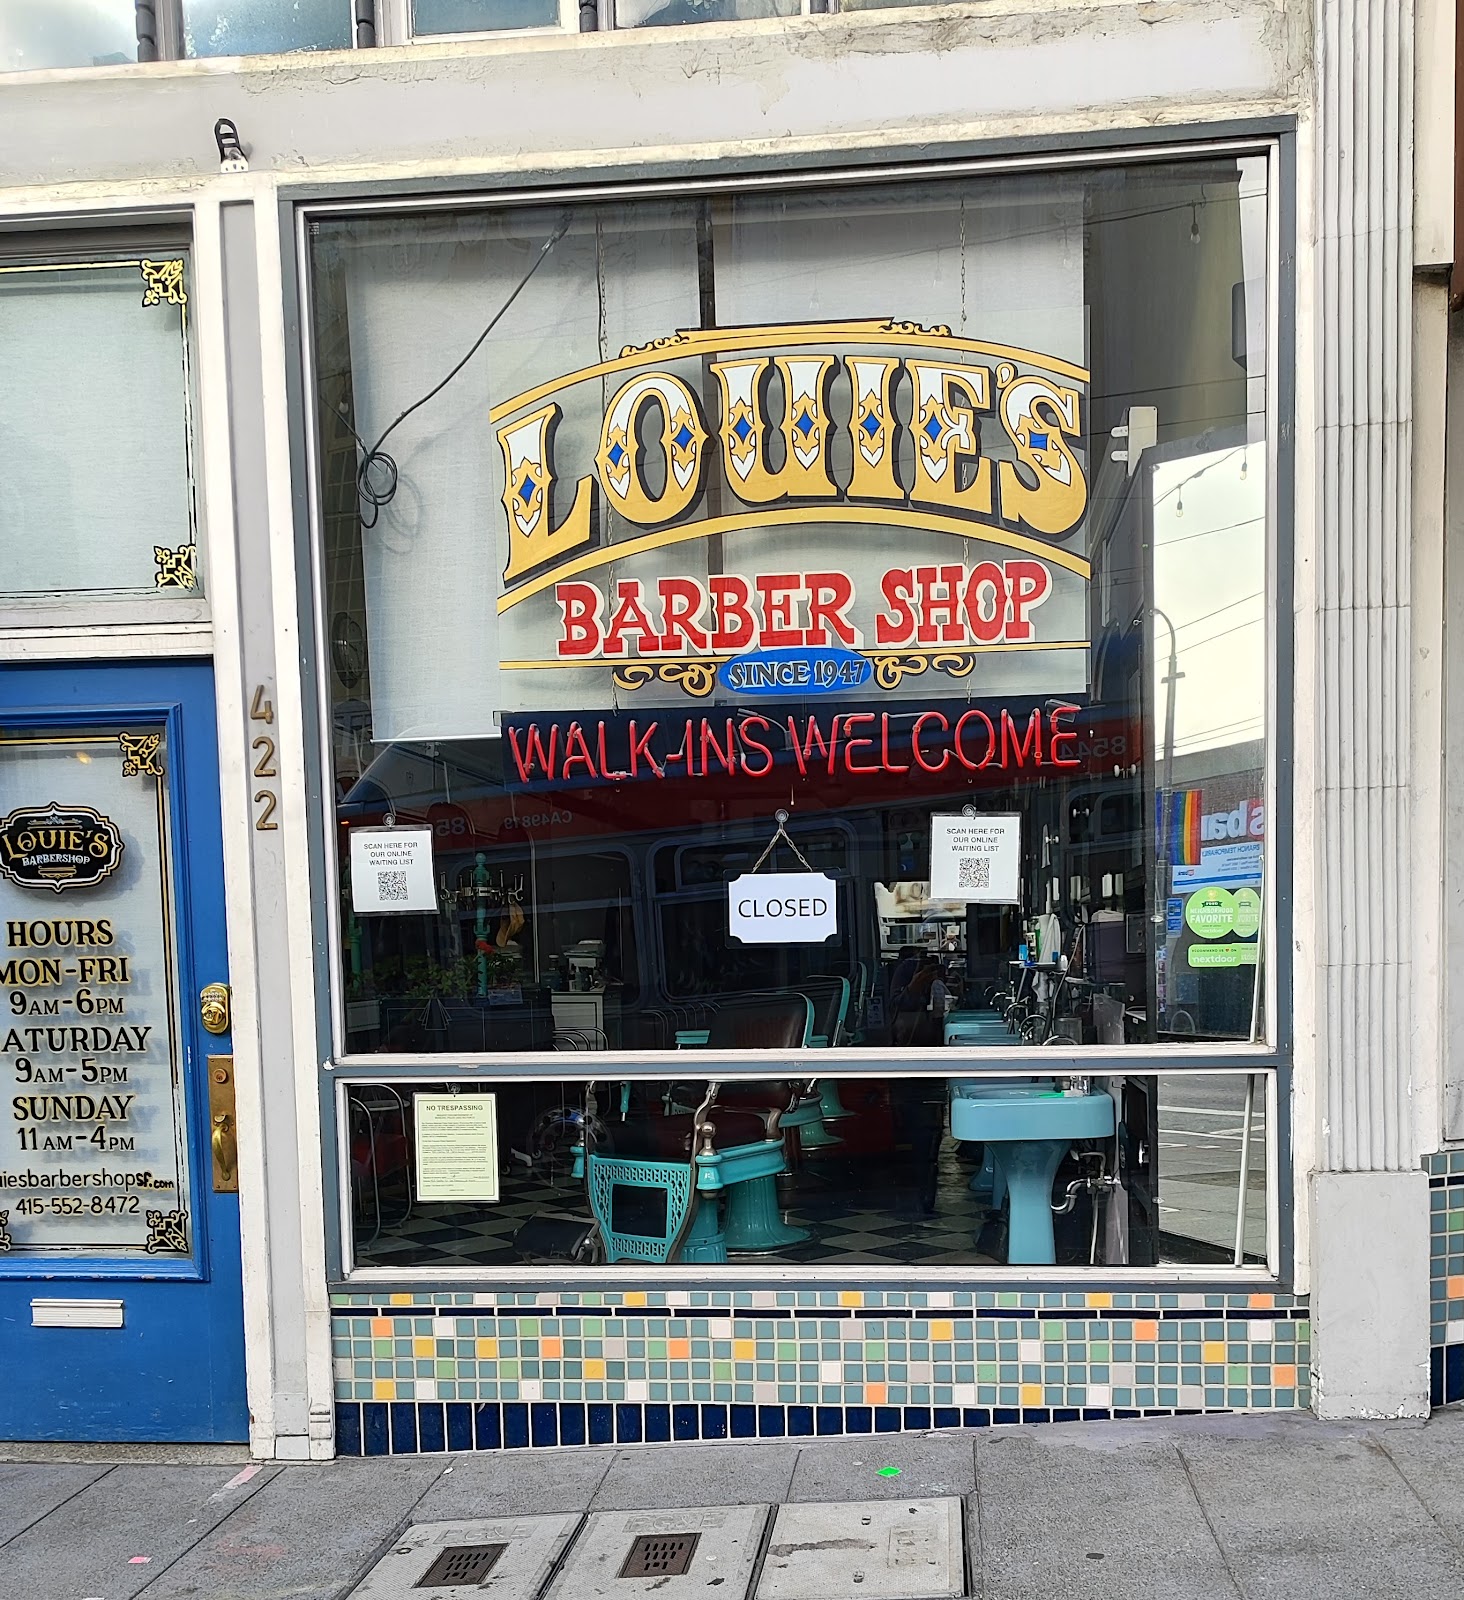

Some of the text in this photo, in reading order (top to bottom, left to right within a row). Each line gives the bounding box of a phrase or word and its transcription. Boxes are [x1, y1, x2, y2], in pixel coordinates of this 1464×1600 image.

[498, 353, 1090, 583] LOUIE'S
[554, 559, 1053, 659] BARBER SHOP
[728, 659, 867, 690] SINCE 1947
[508, 706, 1082, 783] WALK-INS WELCOME
[2, 830, 110, 862] LOUIE'S
[22, 853, 91, 867] BARBERSHOP
[738, 898, 828, 918] CLOSED
[1190, 914, 1233, 923] FAVORITE
[7, 919, 114, 947] HOURS
[1192, 954, 1237, 963] nextdoor
[9, 988, 124, 1015] 9AM-6PM
[0, 1026, 152, 1052] ATURDAY
[15, 1057, 128, 1083] 9AM-5PM
[12, 1095, 134, 1121] SUNDAY
[15, 1195, 140, 1215] 415-552-8472
